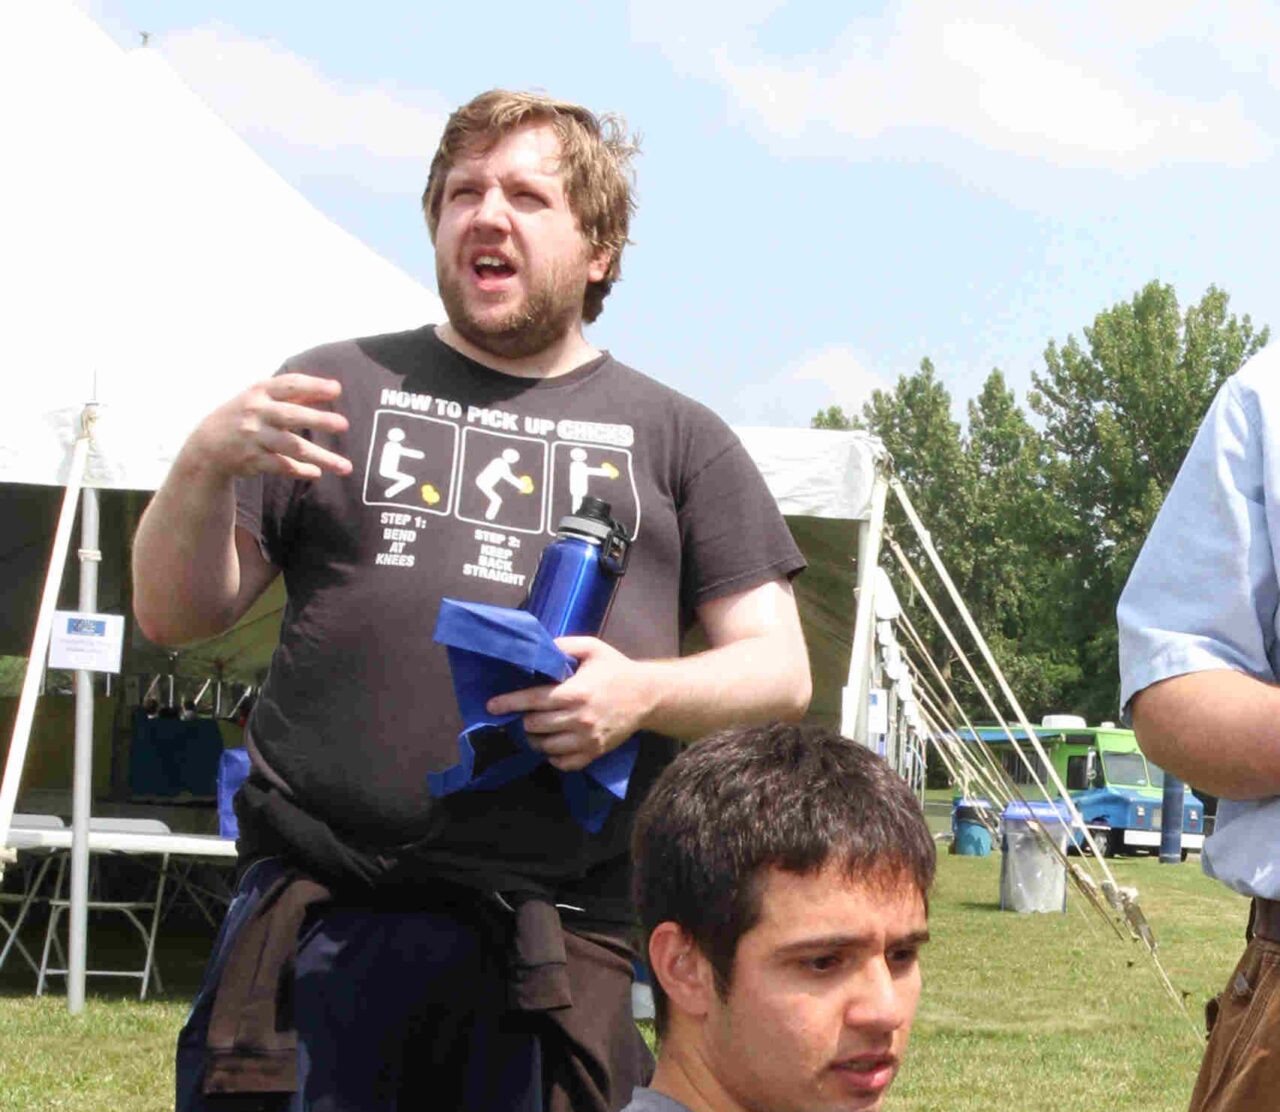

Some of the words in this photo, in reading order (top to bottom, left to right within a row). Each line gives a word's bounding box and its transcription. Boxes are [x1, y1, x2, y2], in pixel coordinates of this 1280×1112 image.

[380, 388, 432, 411] HOW
[435, 398, 462, 418] TO
[467, 405, 519, 431] PICK
[524, 416, 555, 435] UP
[380, 512, 412, 526] STEP
[414, 516, 427, 529] 1:
[383, 528, 417, 542] BEND
[474, 529, 506, 545] STEP
[389, 541, 406, 554] AT
[375, 553, 416, 567] KNEES
[478, 555, 513, 572] BACK
[462, 563, 526, 586] STRAIGHT
